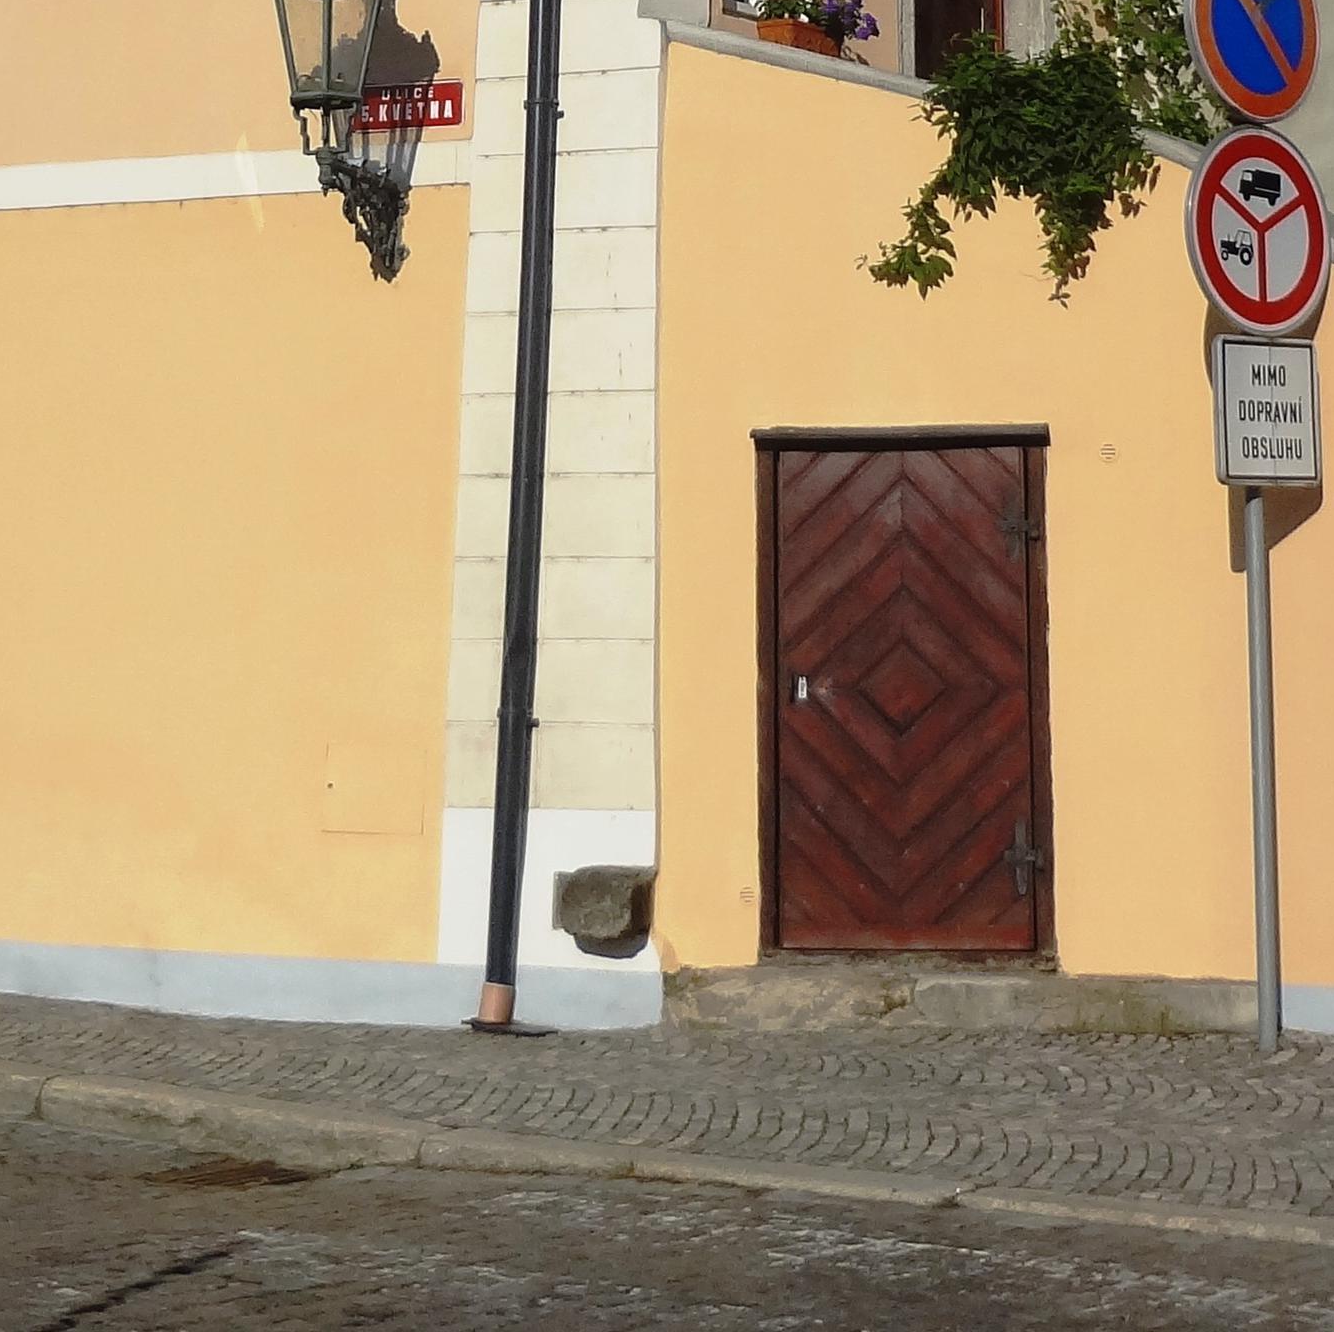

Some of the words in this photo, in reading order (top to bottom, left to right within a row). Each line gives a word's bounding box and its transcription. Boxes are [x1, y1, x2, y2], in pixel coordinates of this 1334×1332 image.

[381, 86, 434, 100] ULICE
[361, 105, 374, 122] 5.
[378, 99, 453, 122] KVĚTNA
[1251, 364, 1286, 387] MIMO
[1238, 396, 1303, 424] DOPRAVNÍ
[1242, 436, 1302, 460] OBSLUHU
